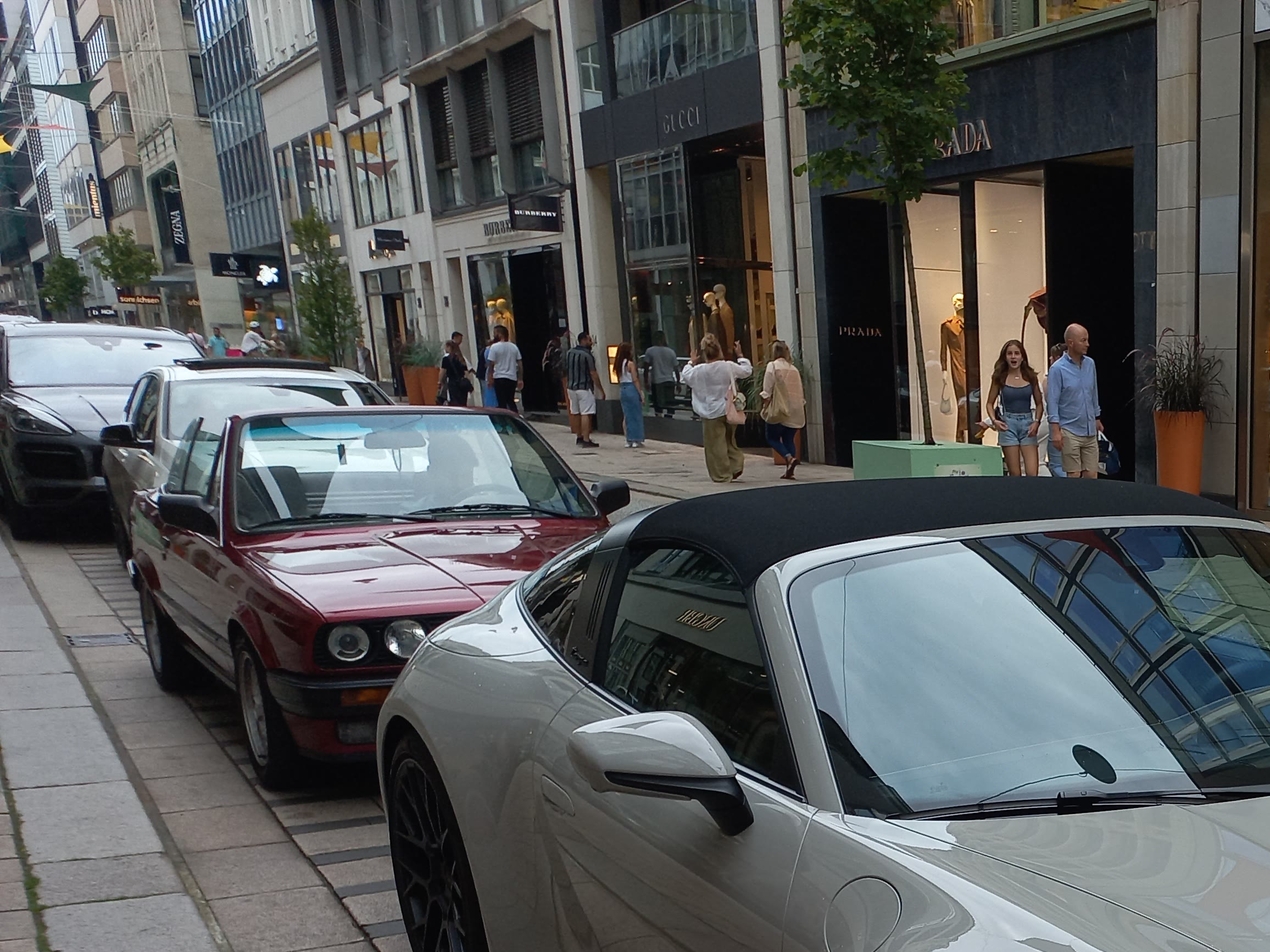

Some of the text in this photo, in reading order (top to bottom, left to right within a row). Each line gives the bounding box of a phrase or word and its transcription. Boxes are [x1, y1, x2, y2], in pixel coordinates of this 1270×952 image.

[663, 106, 700, 134] GUCCI
[514, 209, 557, 217] BURBERRY
[170, 210, 185, 245] ZEGNA
[838, 325, 882, 337] PRADA
